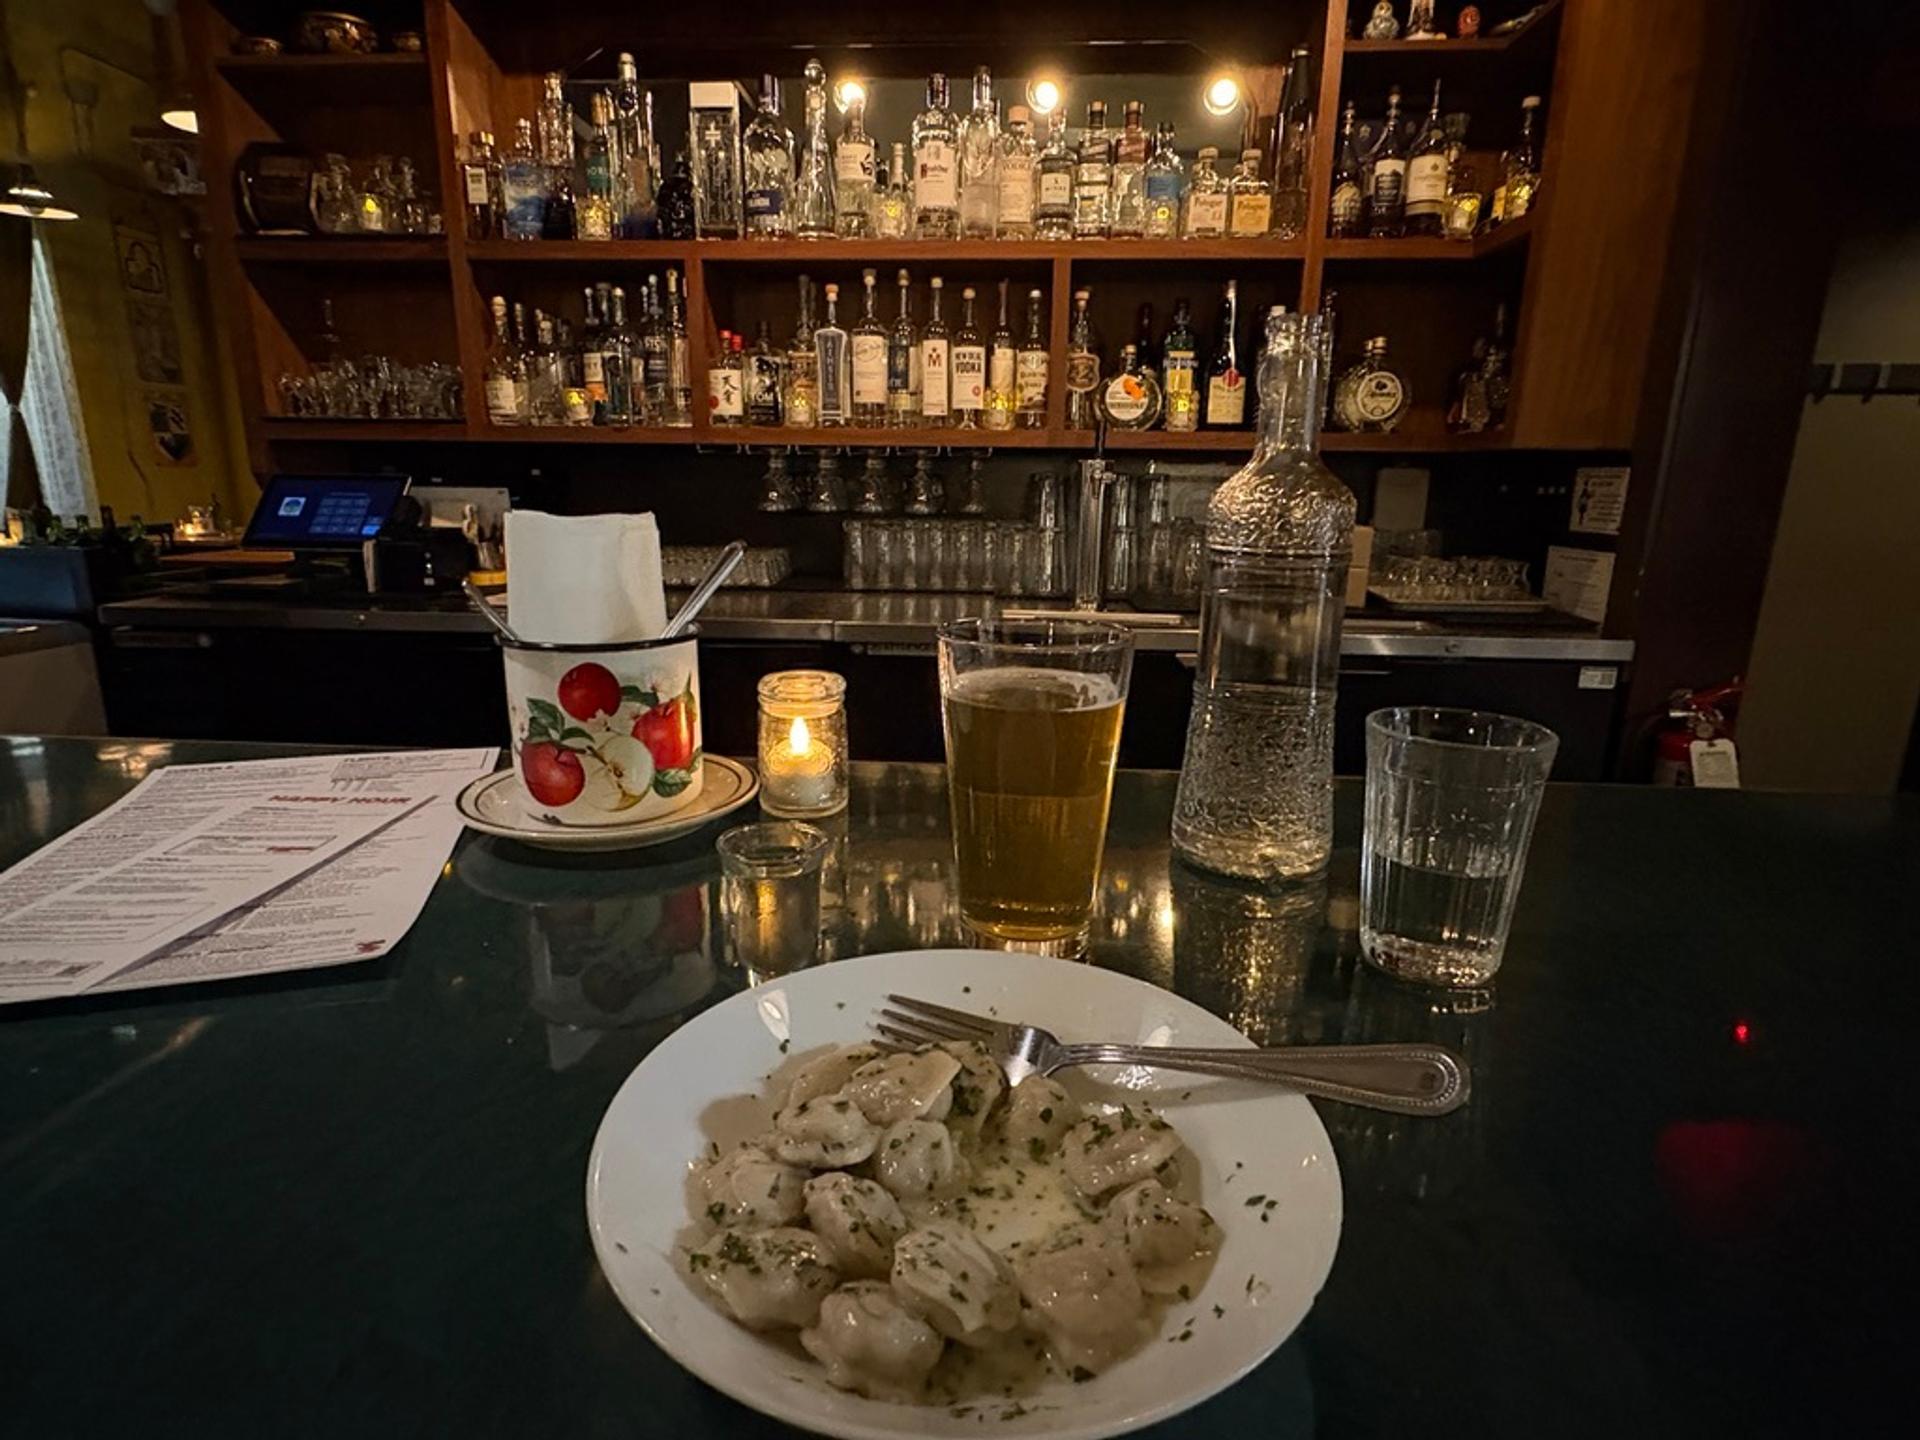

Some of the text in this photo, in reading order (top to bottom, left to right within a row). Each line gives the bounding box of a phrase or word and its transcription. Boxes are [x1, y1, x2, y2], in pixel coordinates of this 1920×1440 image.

[956, 362, 982, 374] VODKA
[268, 795, 411, 804] HAPPY HOUR
